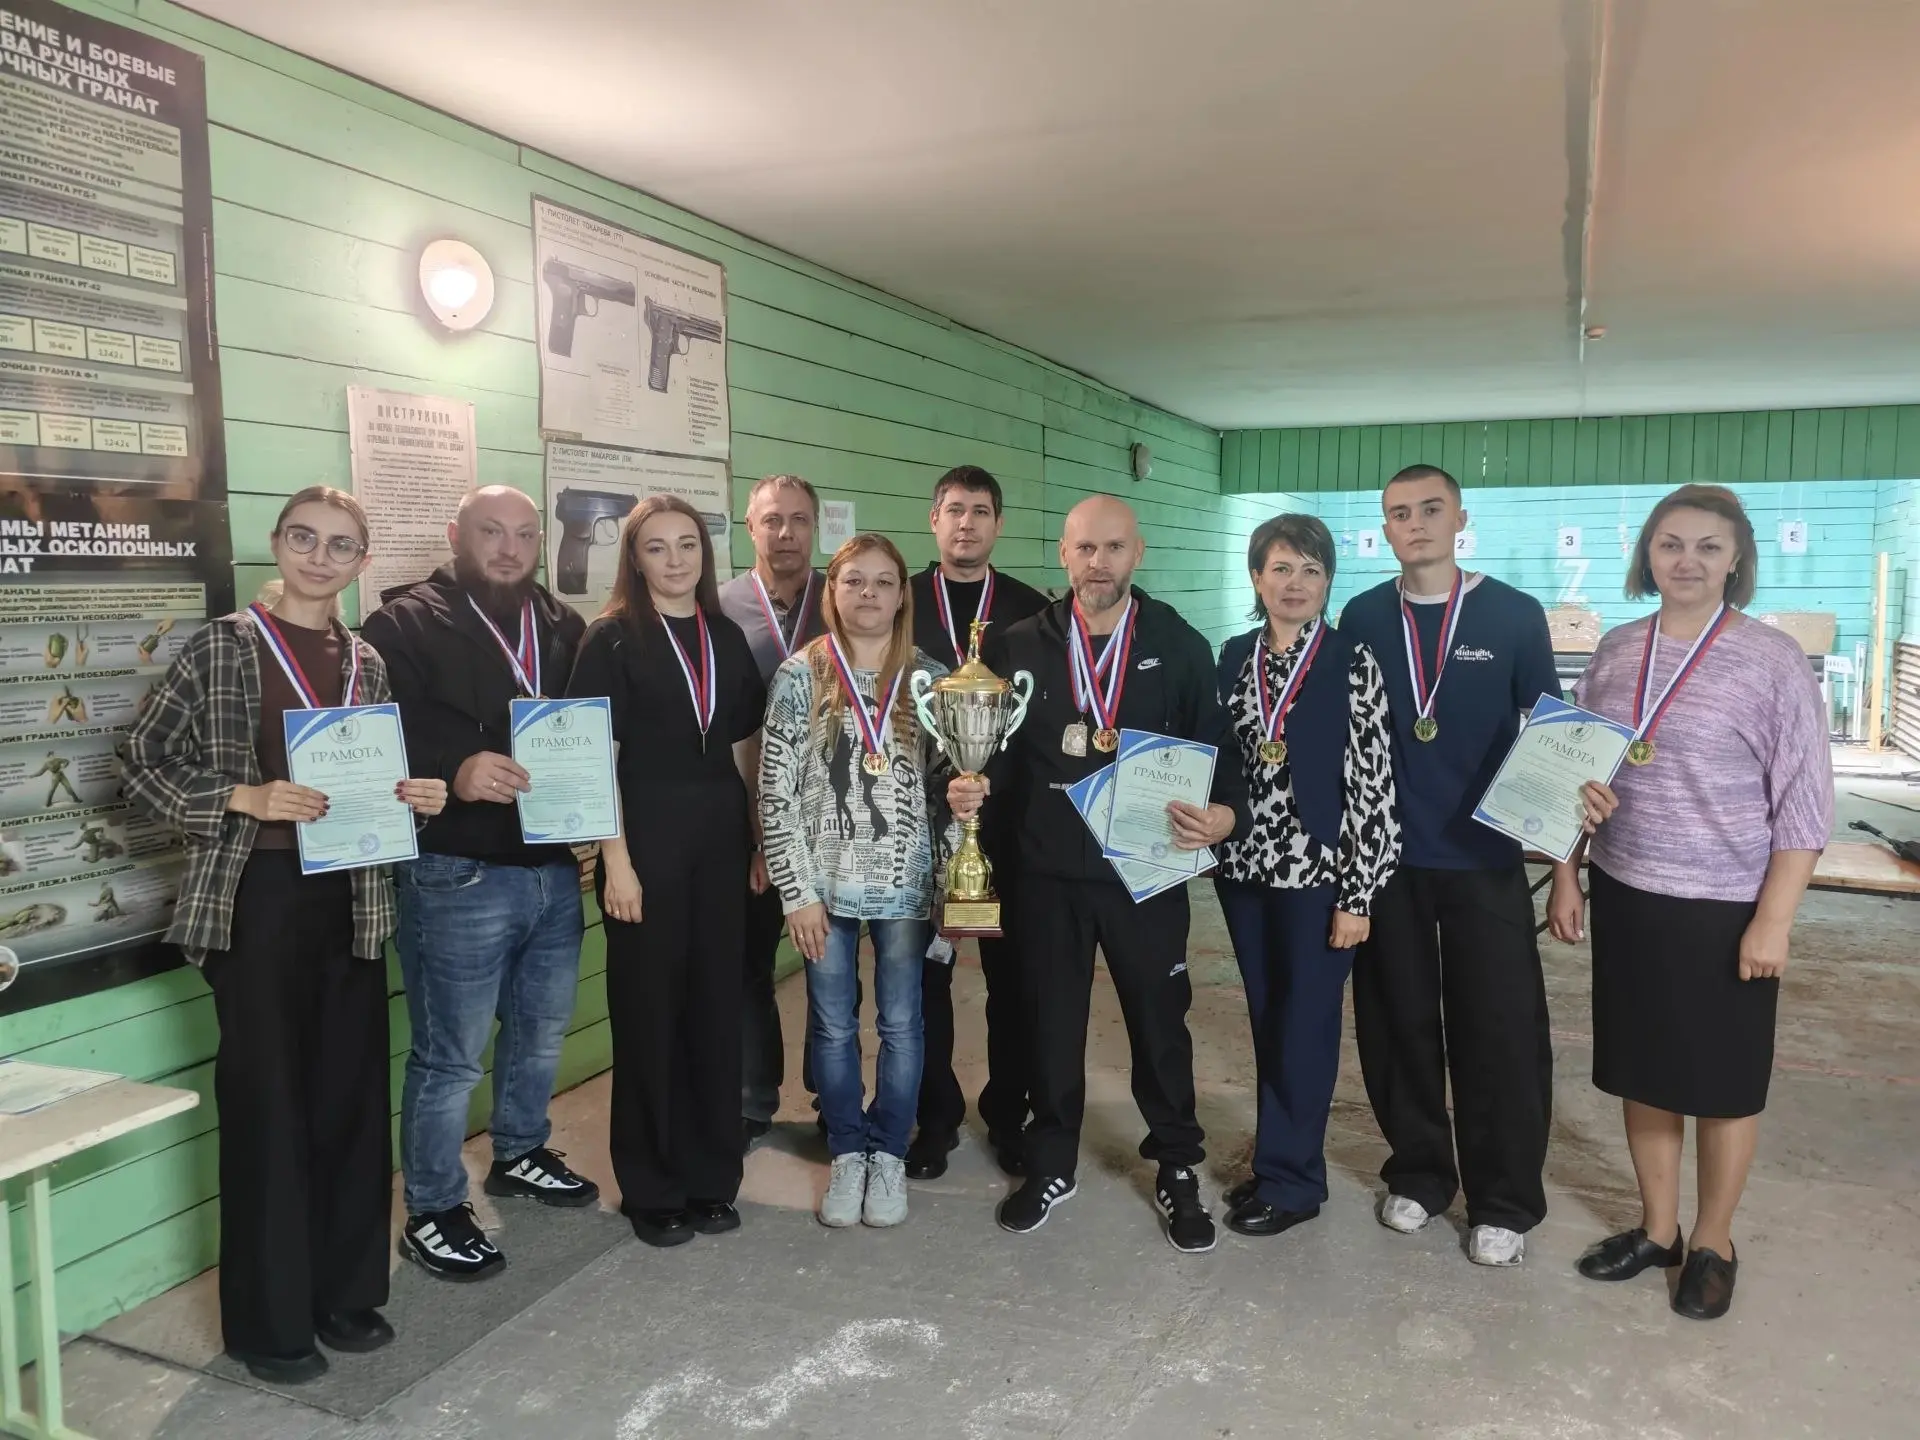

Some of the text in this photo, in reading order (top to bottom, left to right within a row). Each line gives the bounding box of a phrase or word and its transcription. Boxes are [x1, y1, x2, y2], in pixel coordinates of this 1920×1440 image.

[1, 31, 130, 89] ВА РУЧНЫХ
[66, 33, 82, 54] И
[88, 41, 177, 87] БОЕВЫЕ
[77, 76, 160, 115] ГРАНАТ
[28, 176, 71, 193] ГРАНАТА
[84, 171, 123, 189] ГРАНАТ
[547, 208, 580, 226] ПИСТОЛЕТ
[582, 219, 612, 239] ТОКАРЕВА
[33, 272, 75, 287] ГРАНАТА
[77, 280, 102, 291] РГ-42
[38, 365, 82, 379] ГРАНАТА
[84, 371, 99, 380] Ф-1
[558, 447, 589, 460] ПИСТОЛЕТ
[591, 452, 621, 463] МАКАРОВА
[0, 519, 150, 540] МЫ МЕТАНИЯ
[0, 538, 197, 558] ЫХ ОСКОЛОЧНЫХ
[1365, 537, 1373, 549] 1
[1457, 538, 1465, 550] 2
[1565, 535, 1575, 547] 3
[0, 556, 35, 575] АТ
[31, 613, 80, 624] ГРАНАТЫ
[82, 611, 144, 621] НЕОБХОДИМО:
[1455, 648, 1490, 658] Midnight
[22, 671, 72, 683] ГРАНАТЫ
[74, 668, 138, 680] НЕОБХОДИМО:
[25, 729, 75, 743] ГРАНАТЫ
[77, 726, 103, 737] СТОЯ
[531, 736, 592, 749] ГРАМОТА
[310, 746, 384, 764] ГРАМОТА
[1537, 733, 1596, 767] ГРАМОТА
[1132, 766, 1192, 788] ГРАМОТА
[31, 810, 81, 825] ГРАНАТЫ
[761, 793, 802, 902] Galliano
[38, 876, 68, 889] ЛЕЖА
